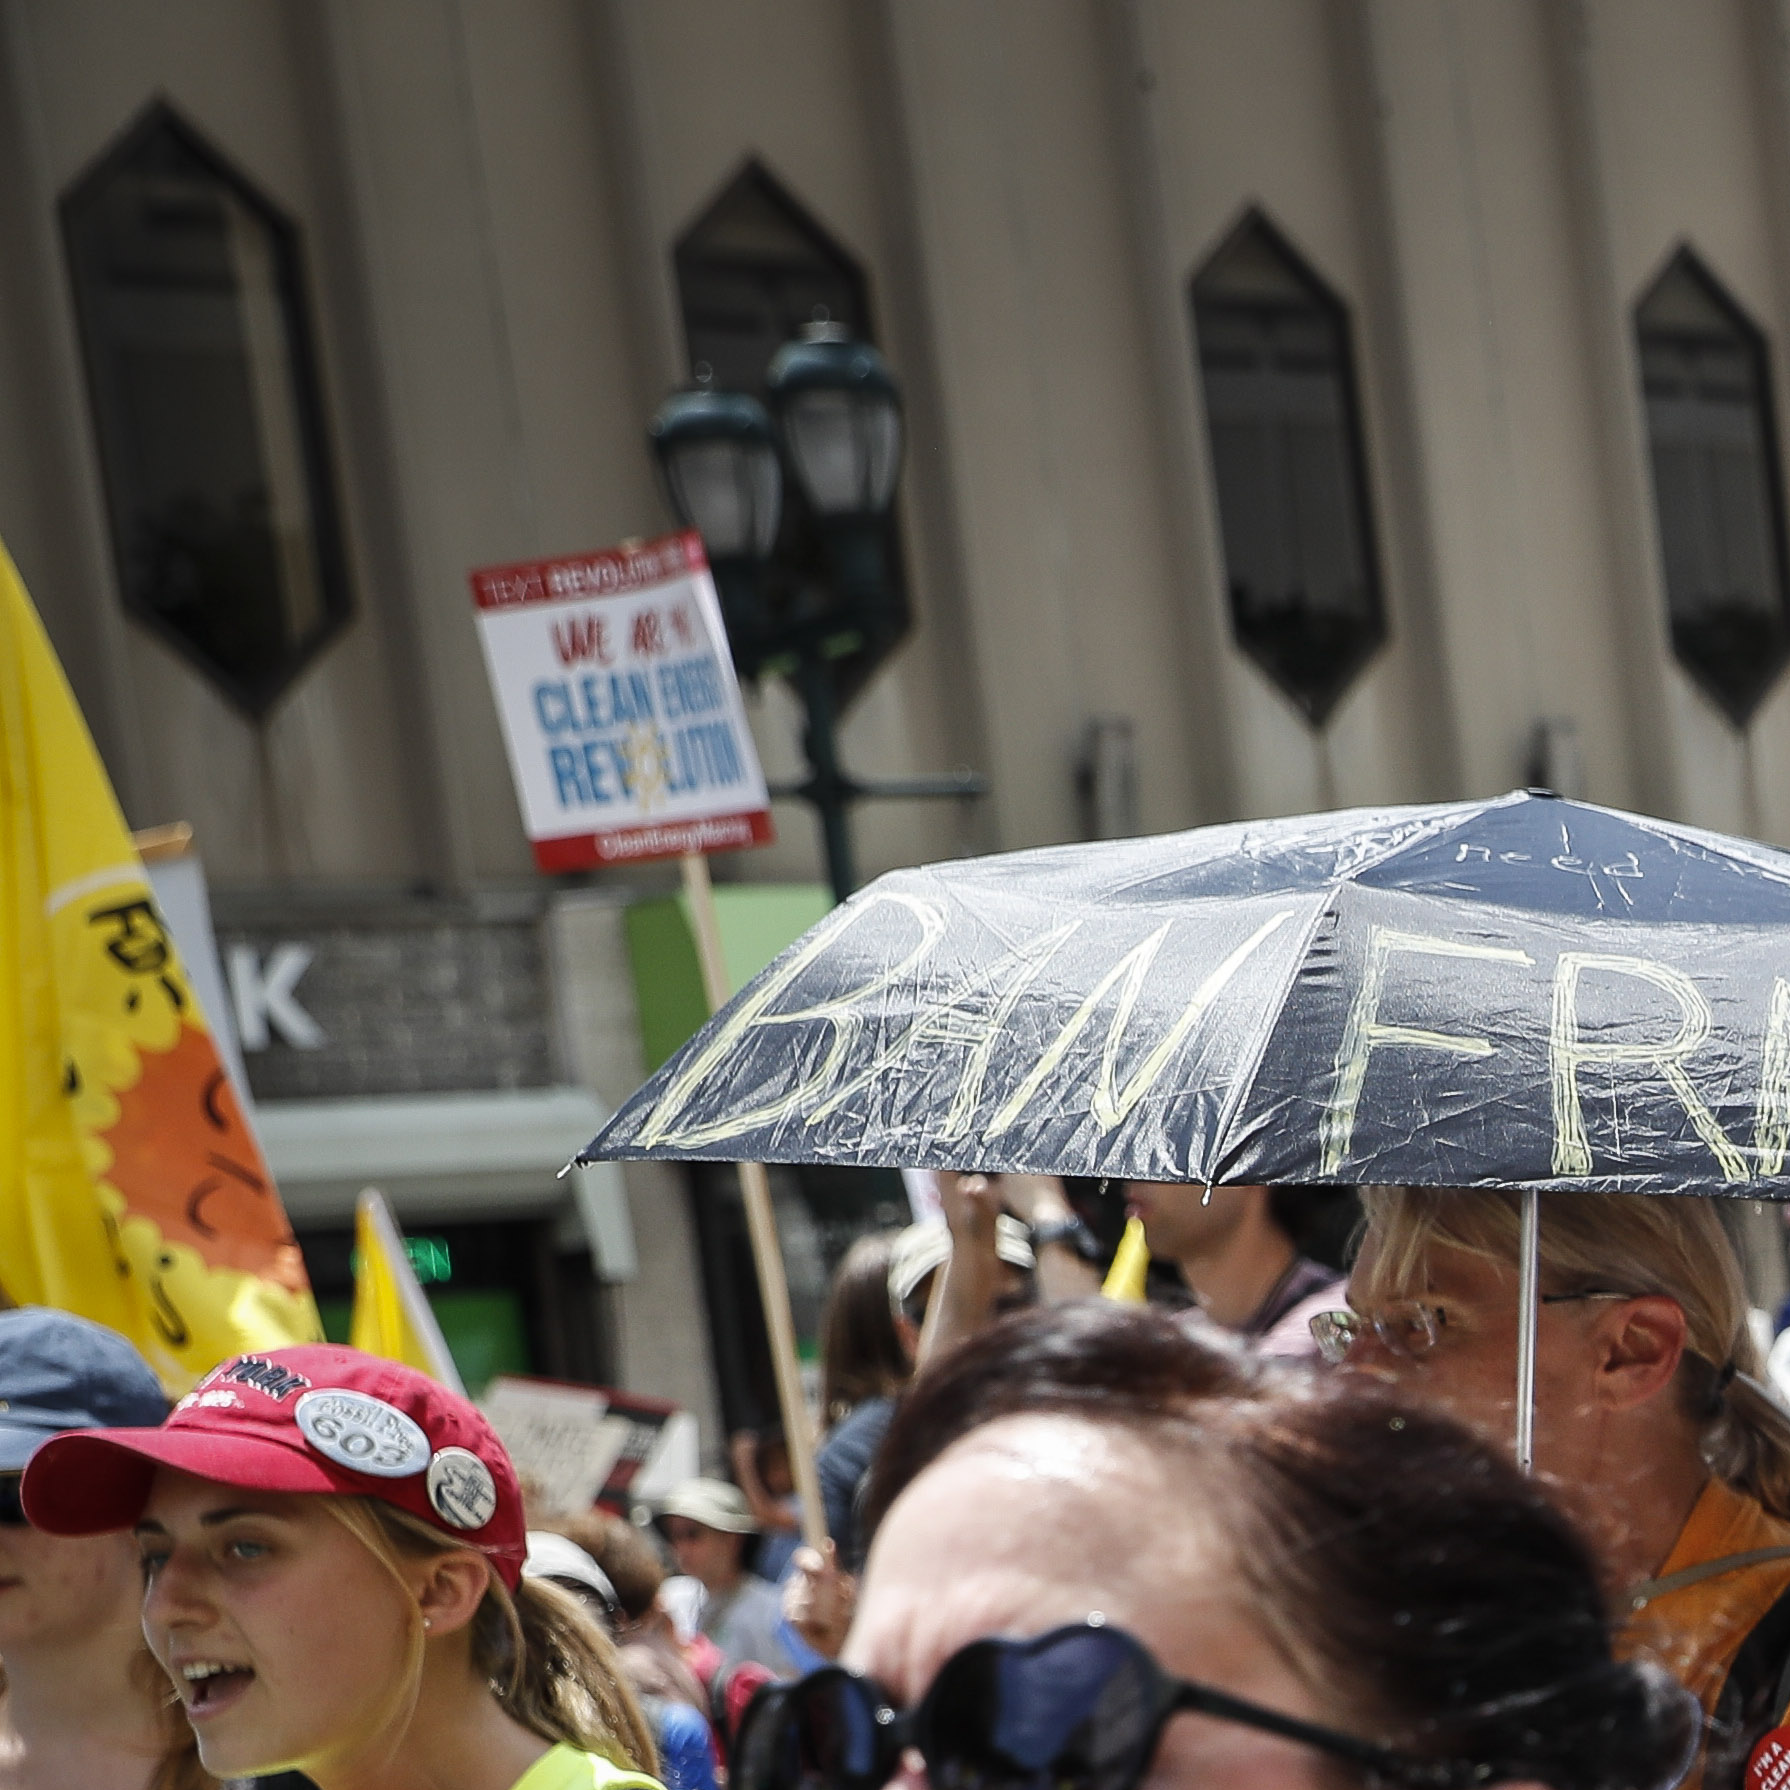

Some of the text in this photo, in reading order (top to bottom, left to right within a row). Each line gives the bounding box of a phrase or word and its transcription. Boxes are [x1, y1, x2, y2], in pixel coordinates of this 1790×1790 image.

[533, 664, 655, 735] CLEAN
[632, 888, 1297, 1149] BAN
[1752, 1741, 1783, 1778] I'M A
